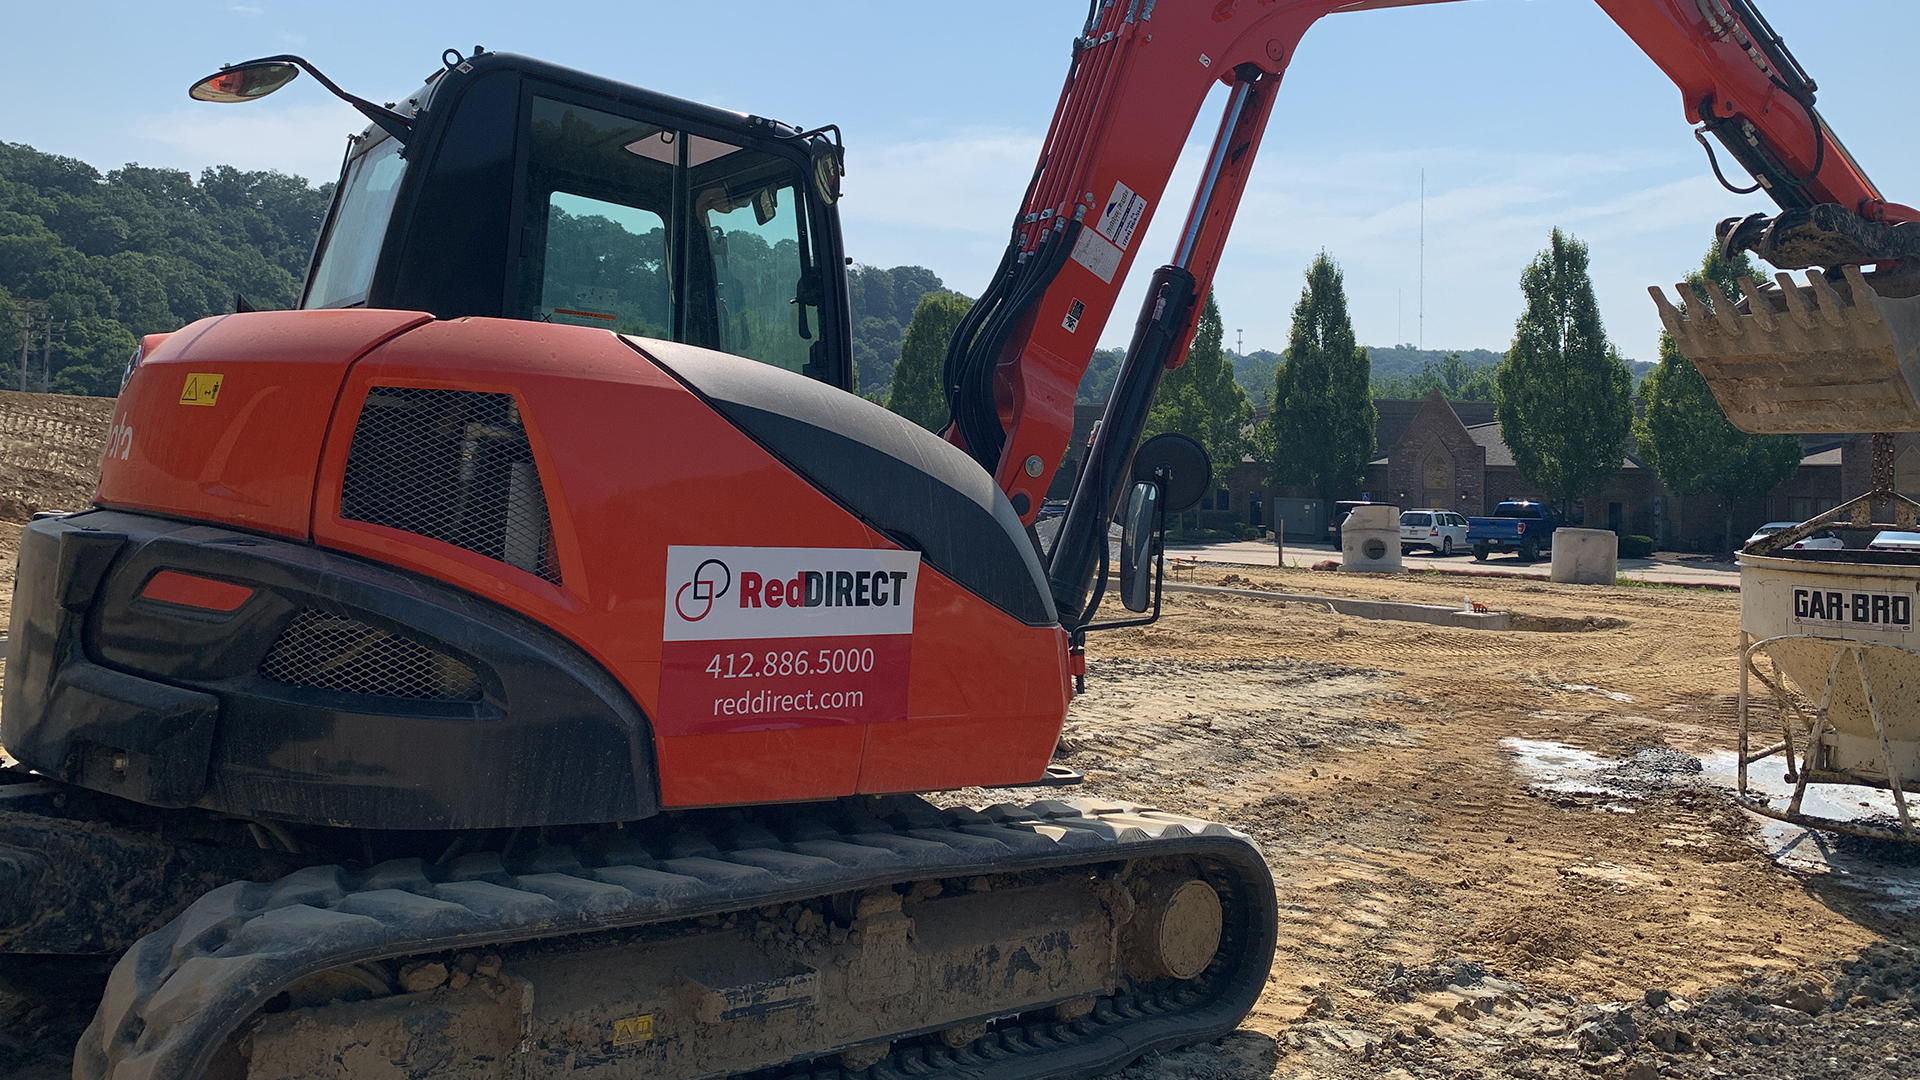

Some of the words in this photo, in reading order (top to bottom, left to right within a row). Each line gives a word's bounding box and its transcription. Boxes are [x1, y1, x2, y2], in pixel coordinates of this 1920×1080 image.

[739, 570, 908, 609] RedDIRECT
[1794, 589, 1910, 625] GAR-BRO
[705, 647, 875, 679] 412.886.5000
[713, 689, 864, 716] reddirect.com
